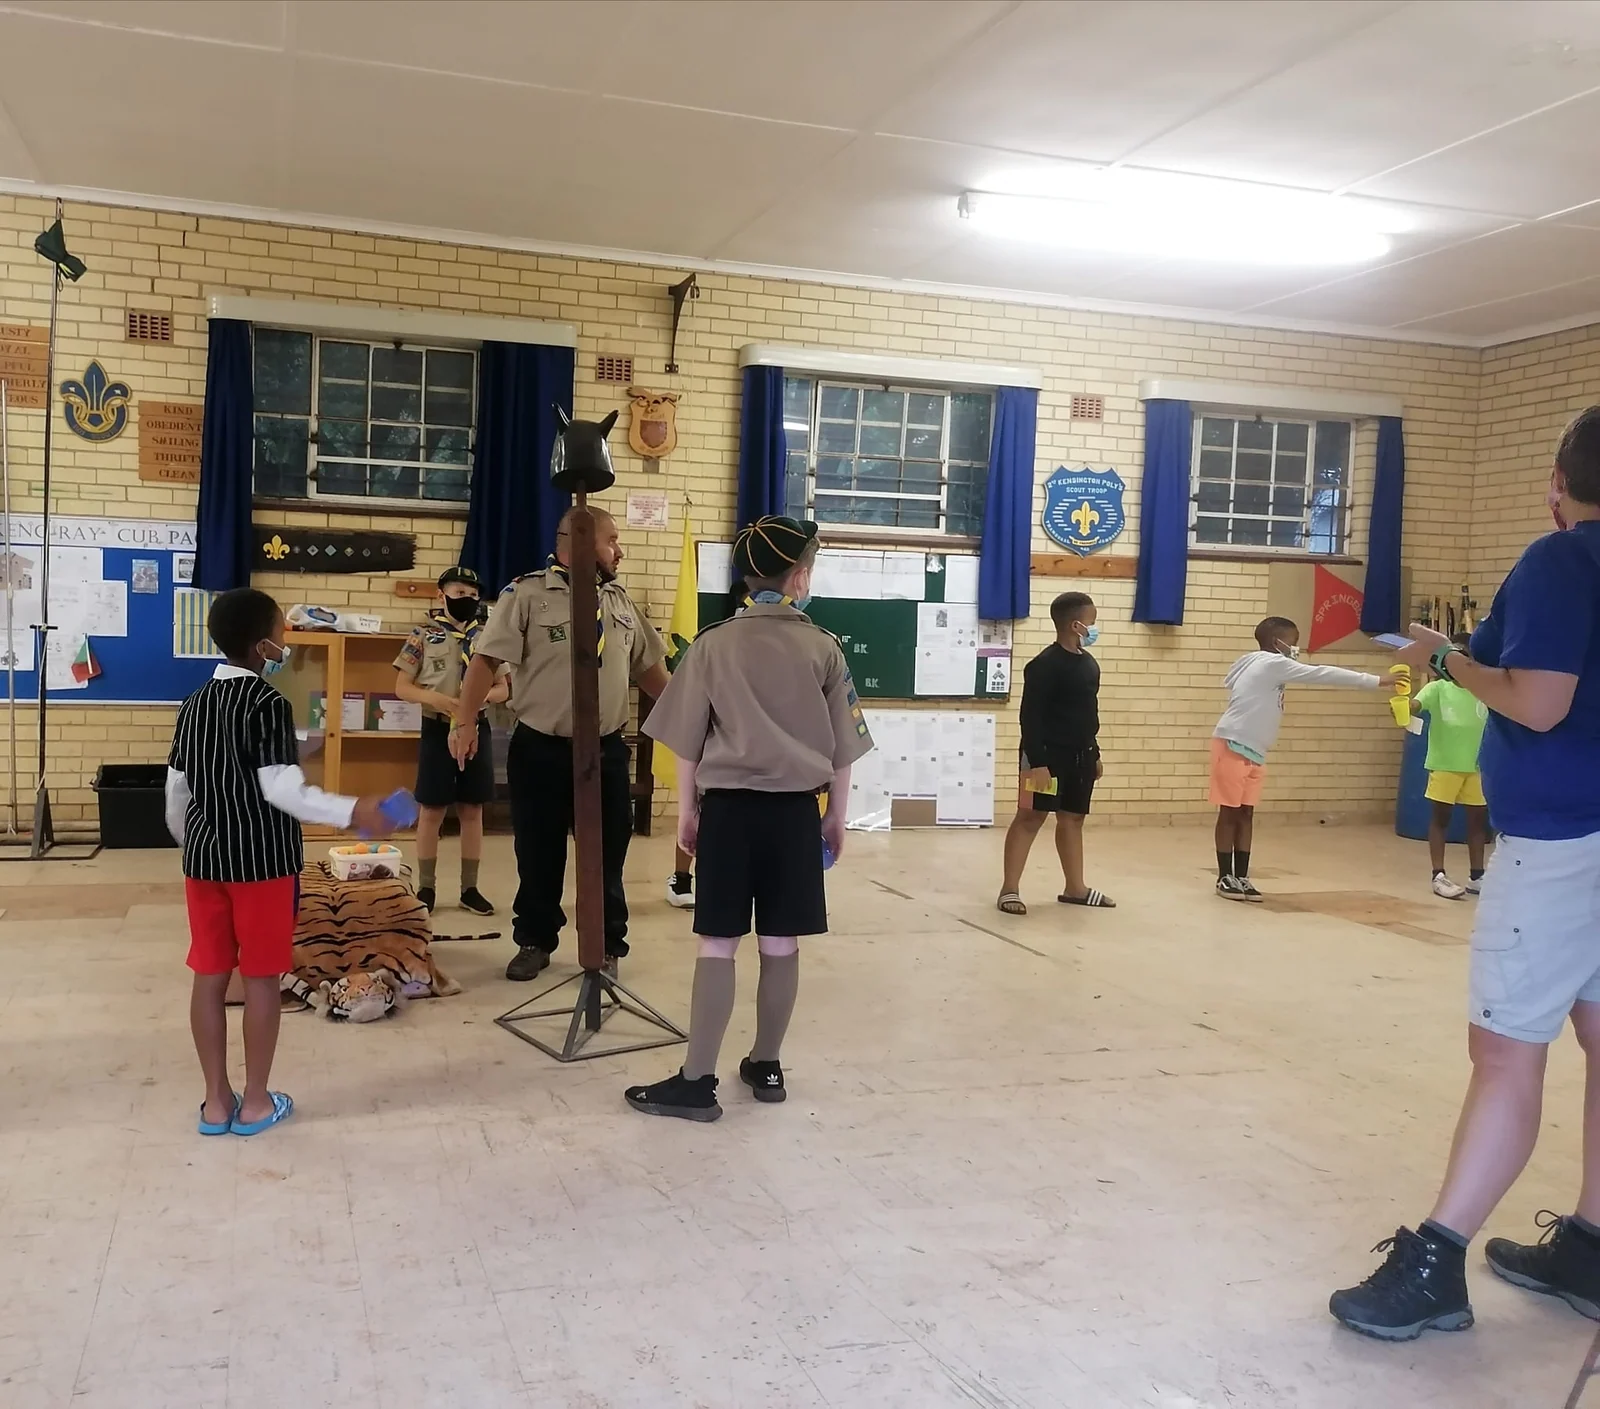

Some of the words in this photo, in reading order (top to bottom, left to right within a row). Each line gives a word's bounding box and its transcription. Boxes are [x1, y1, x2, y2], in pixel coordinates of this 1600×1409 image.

[163, 405, 193, 415] KIND
[146, 420, 202, 432] OBEDIENT
[152, 436, 199, 448] SMILING
[159, 469, 196, 479] CLEAN
[1058, 477, 1100, 485] KENSINGTON
[117, 528, 160, 544] CUB
